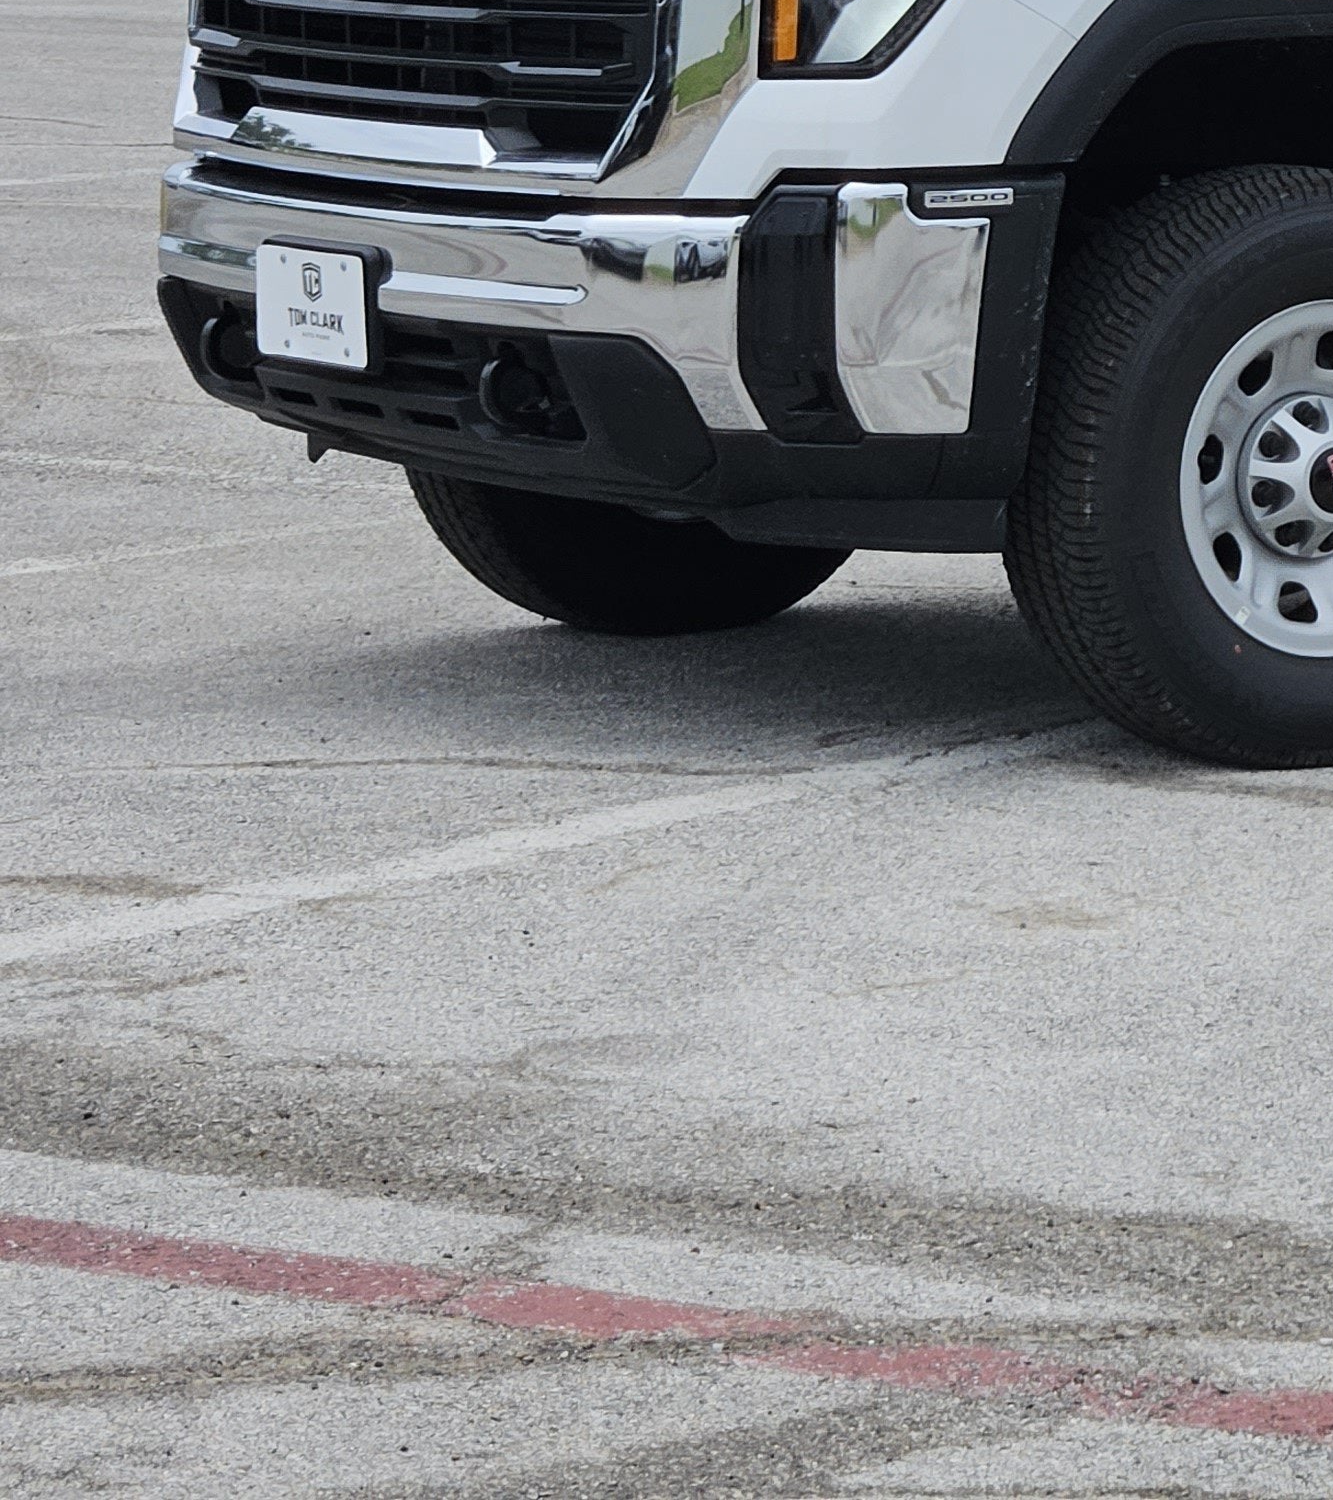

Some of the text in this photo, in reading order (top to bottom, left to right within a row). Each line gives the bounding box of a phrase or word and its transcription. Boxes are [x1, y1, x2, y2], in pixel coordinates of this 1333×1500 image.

[929, 193, 1009, 203] 2500
[288, 307, 345, 335] TOM CLARK
